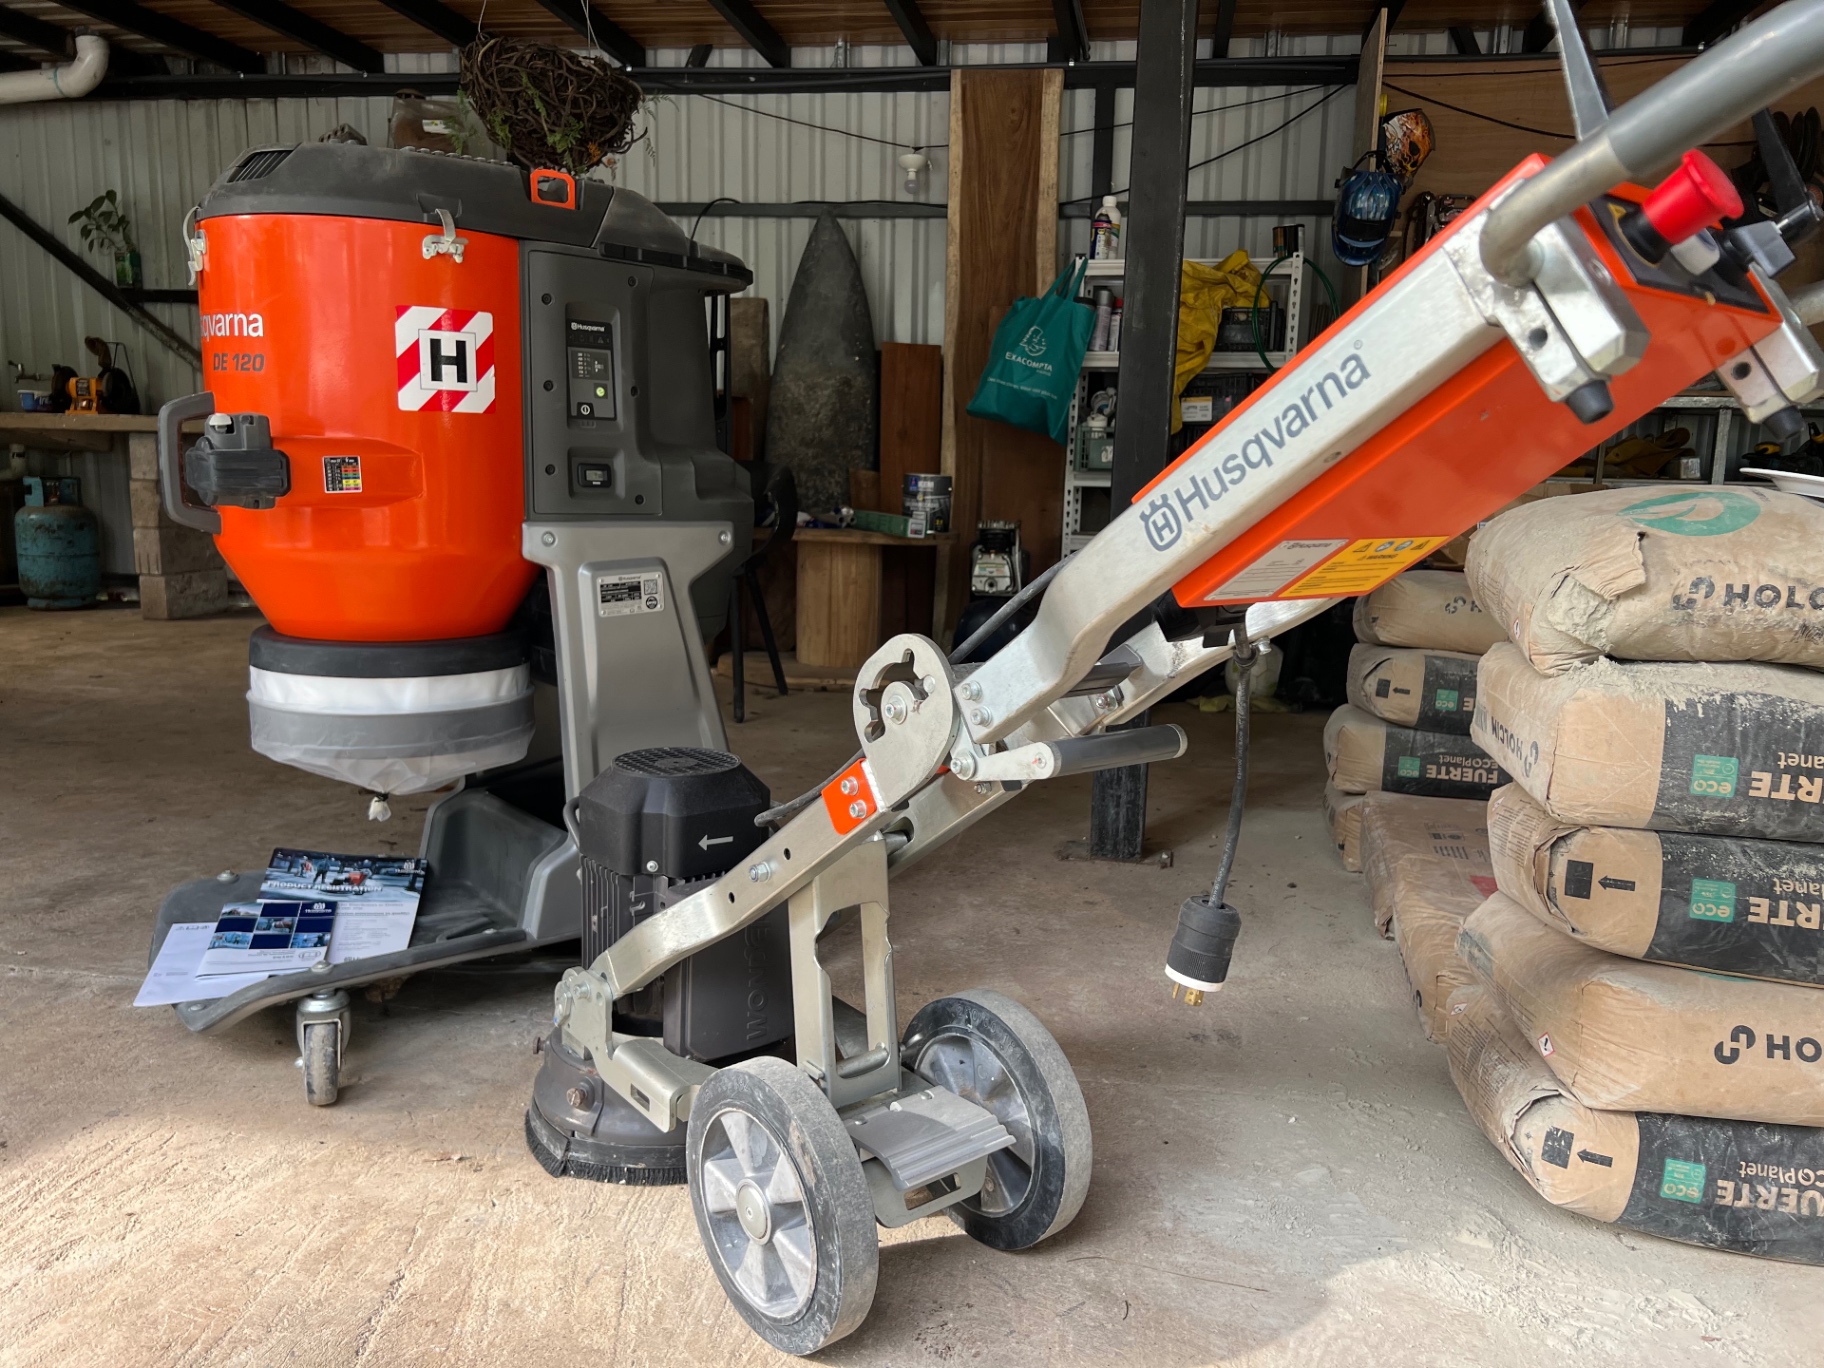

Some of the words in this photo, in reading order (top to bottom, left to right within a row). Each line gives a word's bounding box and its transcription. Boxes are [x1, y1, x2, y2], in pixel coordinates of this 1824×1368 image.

[213, 352, 229, 371] DE
[232, 352, 265, 372] 120
[429, 337, 468, 384] H
[1005, 351, 1053, 372] EXACOMPTA
[1173, 352, 1372, 523] Husqvarna
[1491, 715, 1524, 761] HOLCIM
[1438, 754, 1499, 769] ECOPlanet
[1425, 764, 1498, 784] FUERTE
[1693, 779, 1732, 794] eco
[1748, 770, 1824, 804] RTE
[1692, 902, 1731, 918] eco
[1747, 896, 1824, 930] RTE
[1765, 1033, 1823, 1063] HO
[1663, 1183, 1700, 1199] eco
